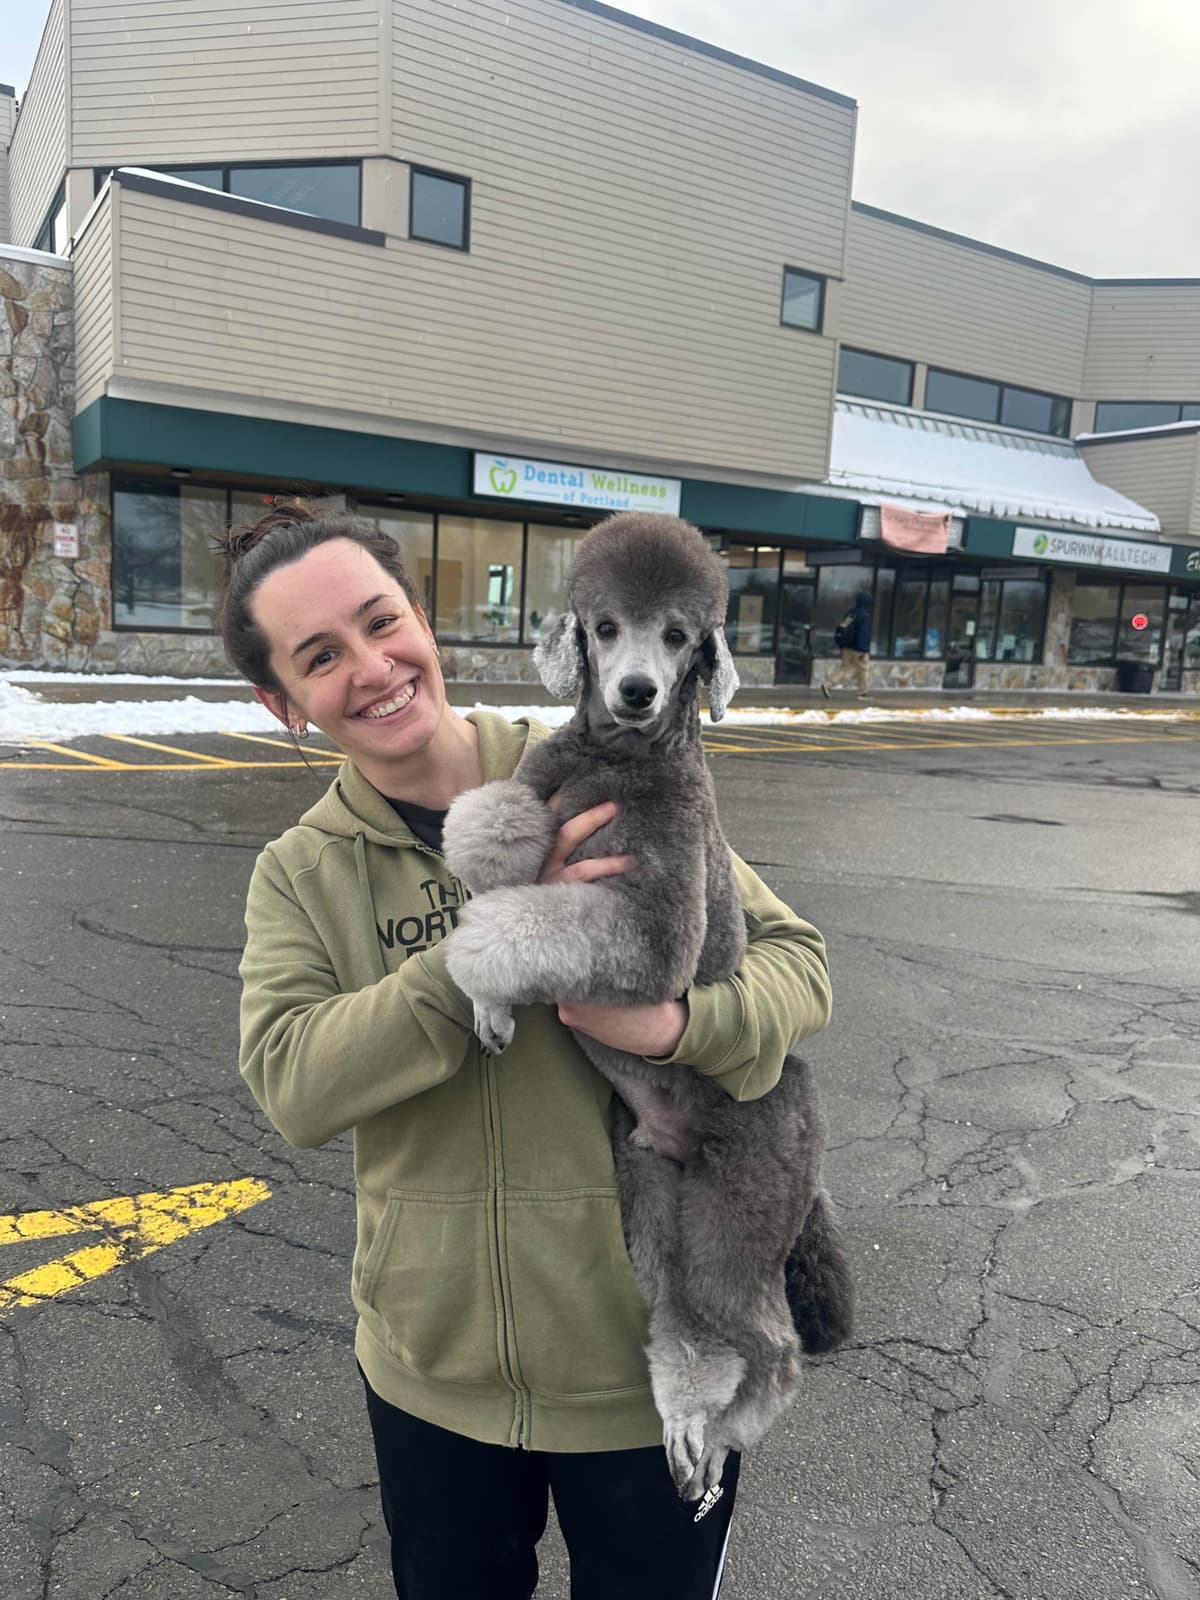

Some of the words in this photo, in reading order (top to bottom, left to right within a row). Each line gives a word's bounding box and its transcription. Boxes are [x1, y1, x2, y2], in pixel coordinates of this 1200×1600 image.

[523, 463, 585, 488] Dental
[591, 473, 667, 498] Wellness
[563, 491, 575, 502] of
[580, 492, 630, 508] Portland
[420, 878, 473, 910] TH
[376, 906, 459, 949] NORT
